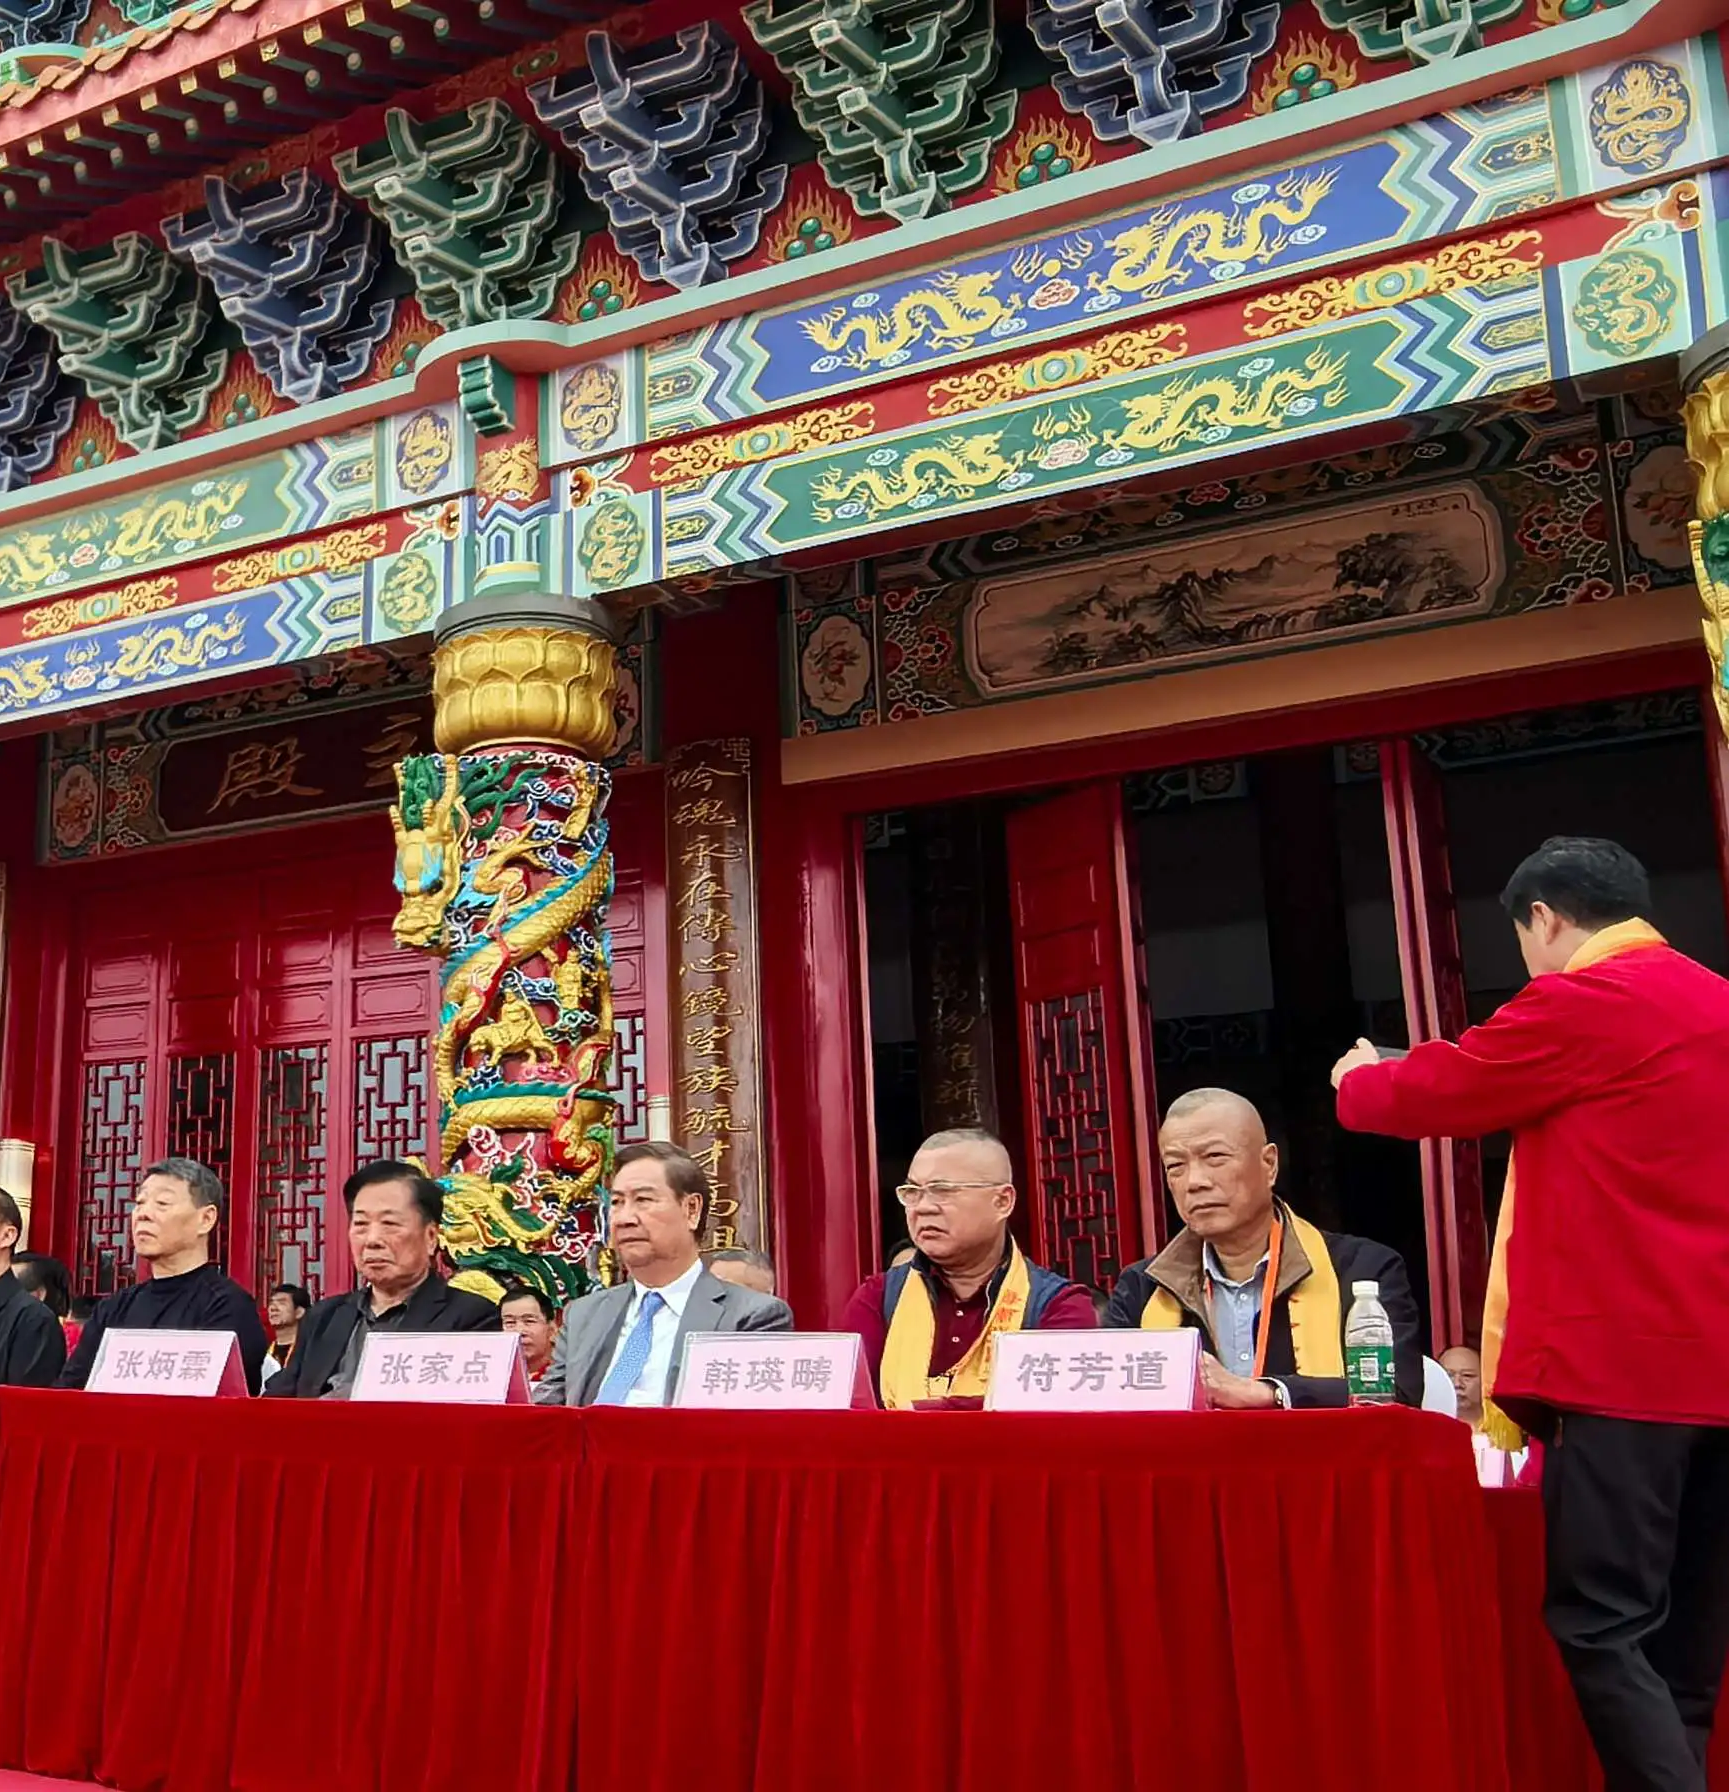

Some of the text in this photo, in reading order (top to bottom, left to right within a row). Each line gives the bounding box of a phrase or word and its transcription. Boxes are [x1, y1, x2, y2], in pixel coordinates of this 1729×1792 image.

[113, 1349, 212, 1381] 张炳霖
[380, 1351, 491, 1385] 张家点
[701, 1356, 833, 1394] 韩瑛畴
[1016, 1352, 1169, 1392] 符芳道
